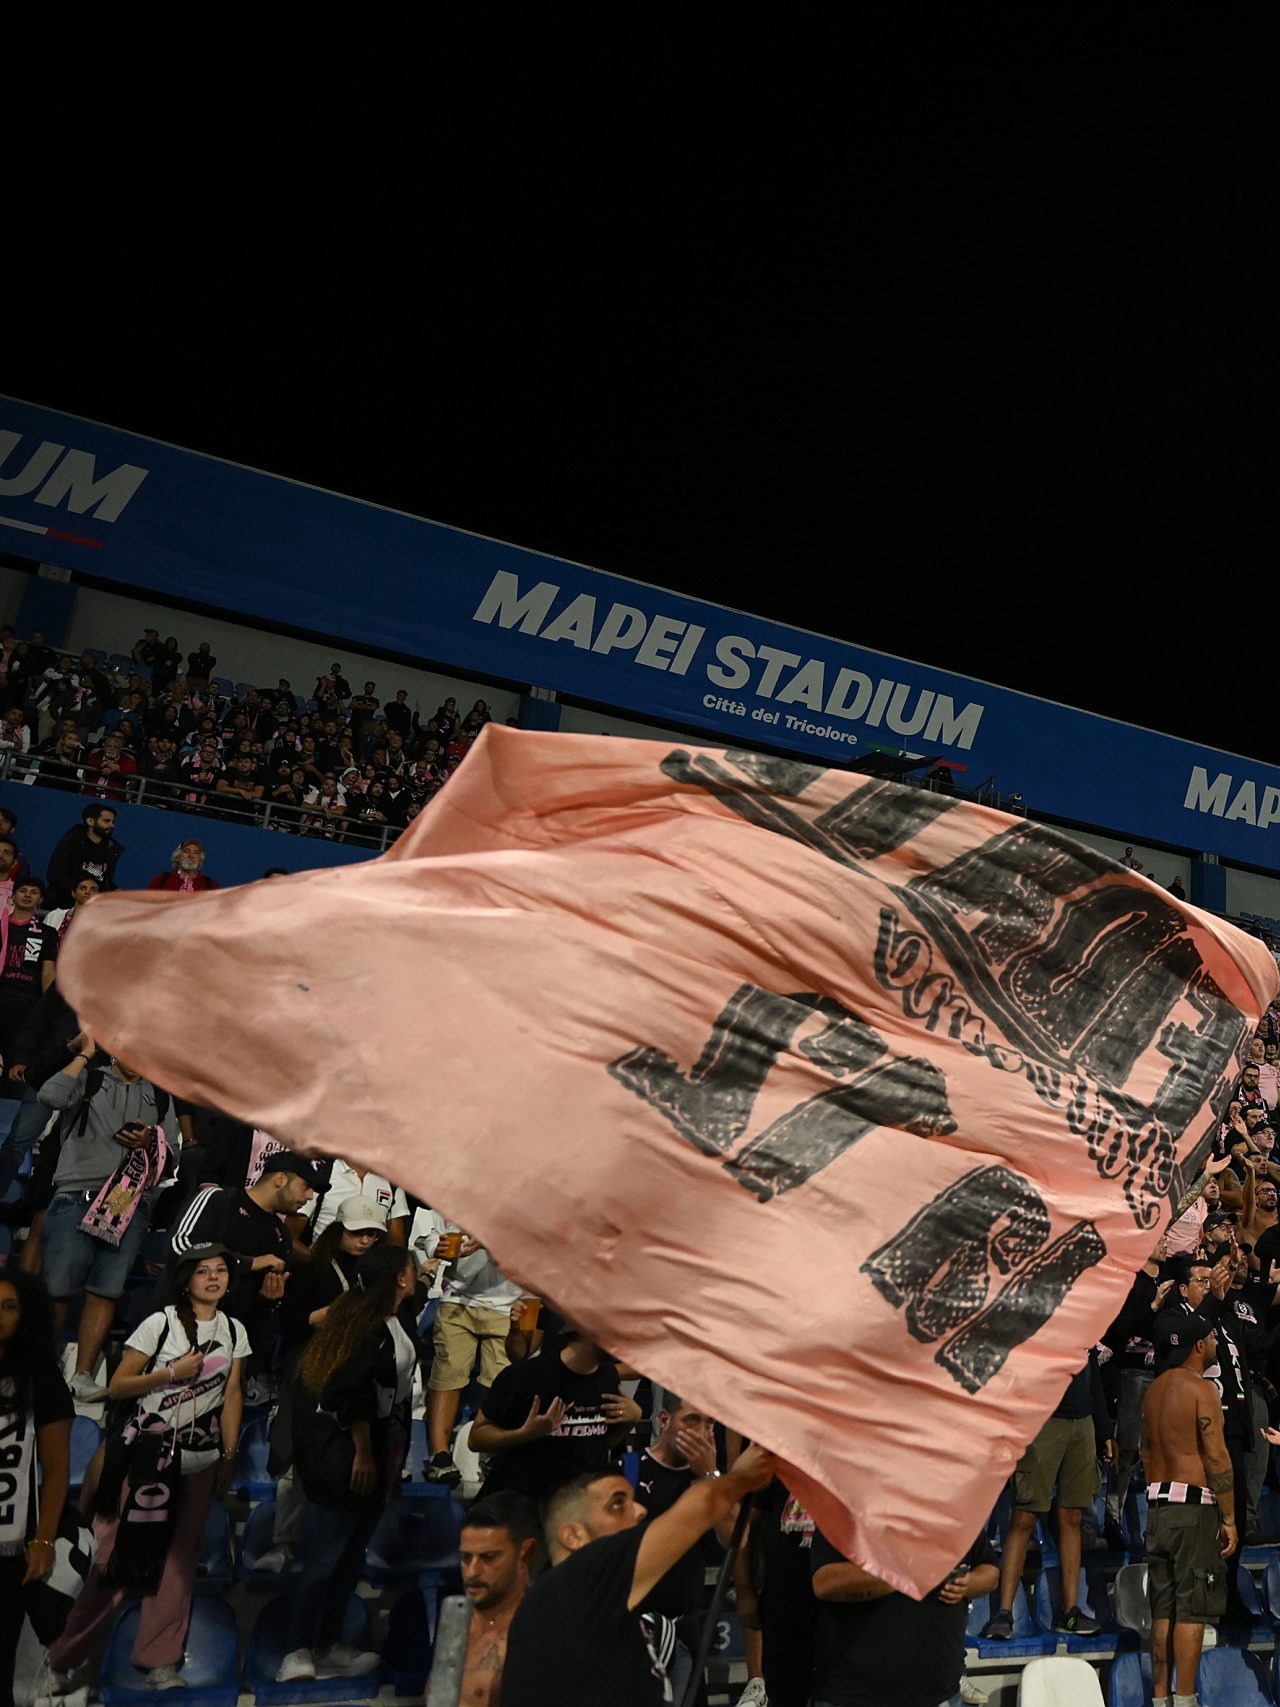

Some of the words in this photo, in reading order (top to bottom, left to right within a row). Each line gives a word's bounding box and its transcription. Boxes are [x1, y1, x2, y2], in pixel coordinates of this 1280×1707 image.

[473, 570, 705, 675] MAPEI
[706, 635, 984, 750] STADIUM
[702, 694, 746, 718] Città
[751, 707, 780, 725] del
[785, 713, 858, 745] Tricolore
